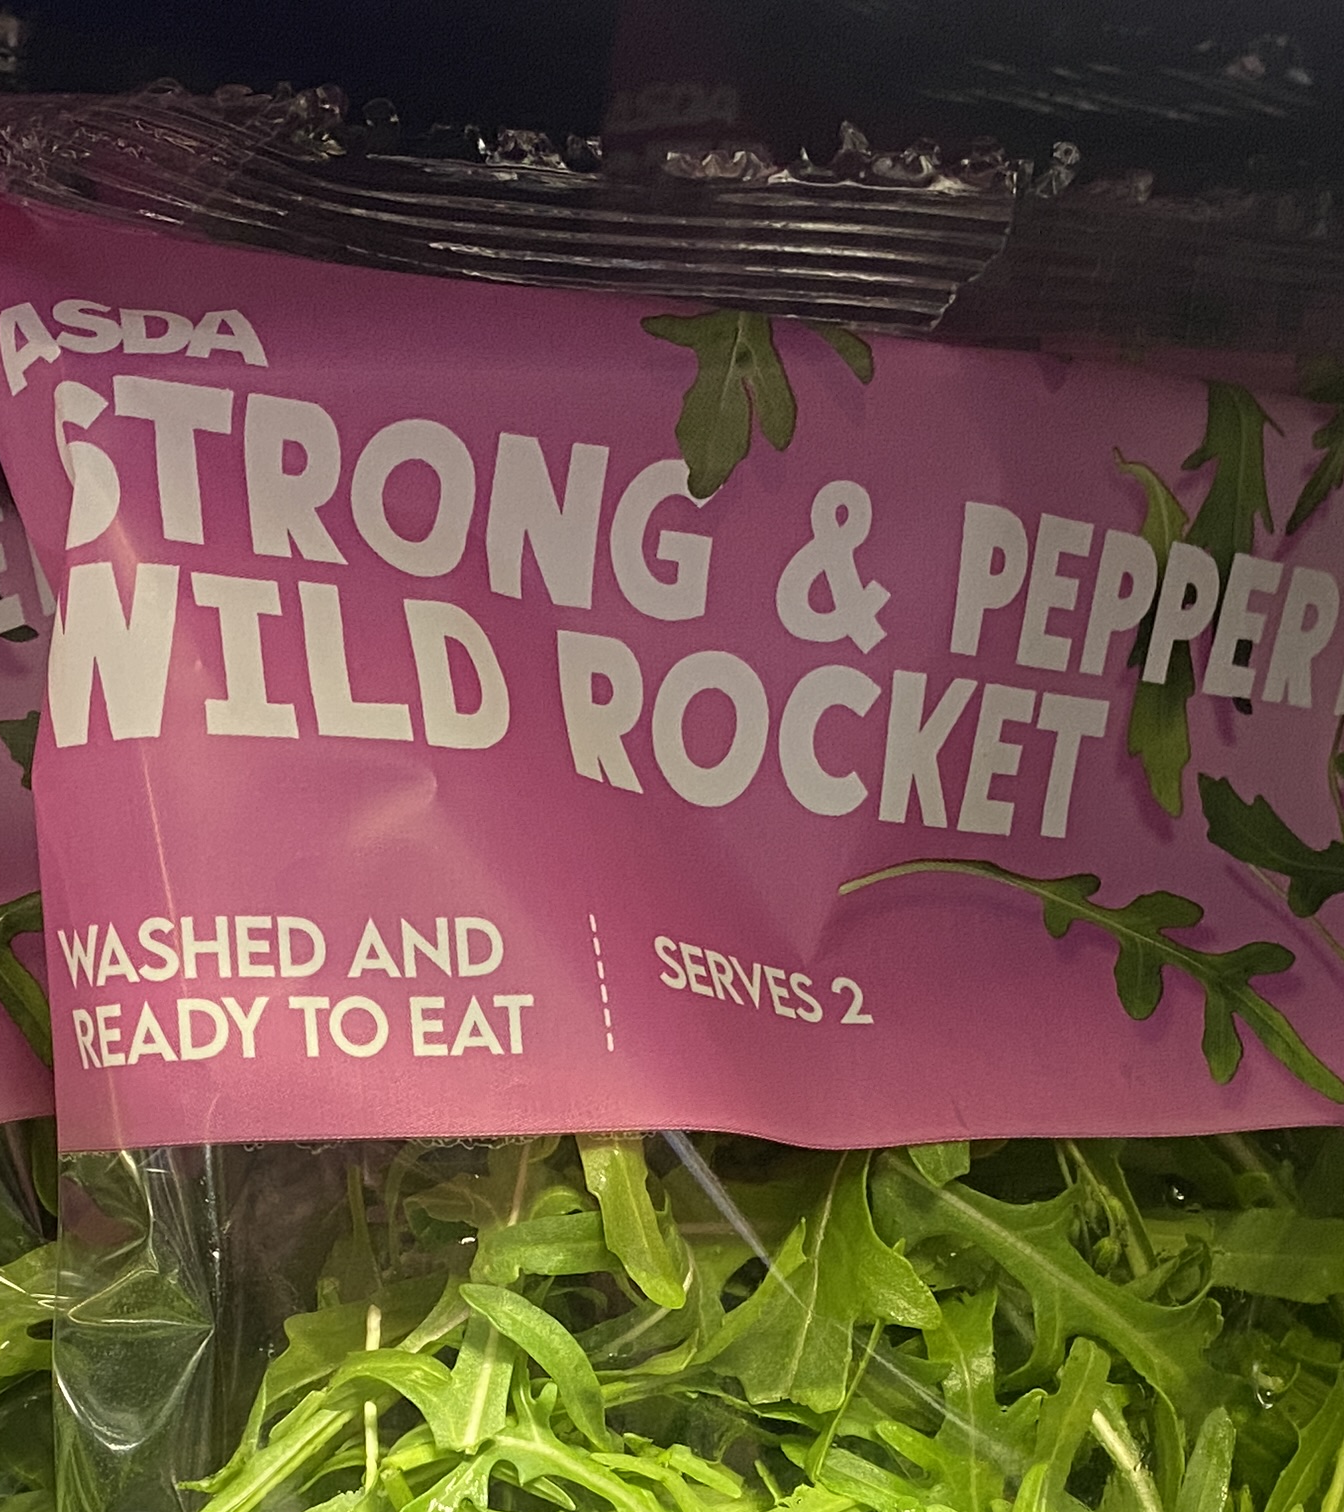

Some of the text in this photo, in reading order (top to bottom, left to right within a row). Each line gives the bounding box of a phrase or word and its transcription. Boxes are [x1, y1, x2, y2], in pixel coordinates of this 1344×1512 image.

[0, 300, 268, 396] ASDA
[54, 375, 712, 622] STRONG
[775, 480, 890, 654] &
[48, 563, 1110, 839] WILD ROCKET
[57, 916, 504, 989] WASHED AND
[654, 935, 874, 1024] SERVES 2
[72, 994, 534, 1070] READY TO EAT
